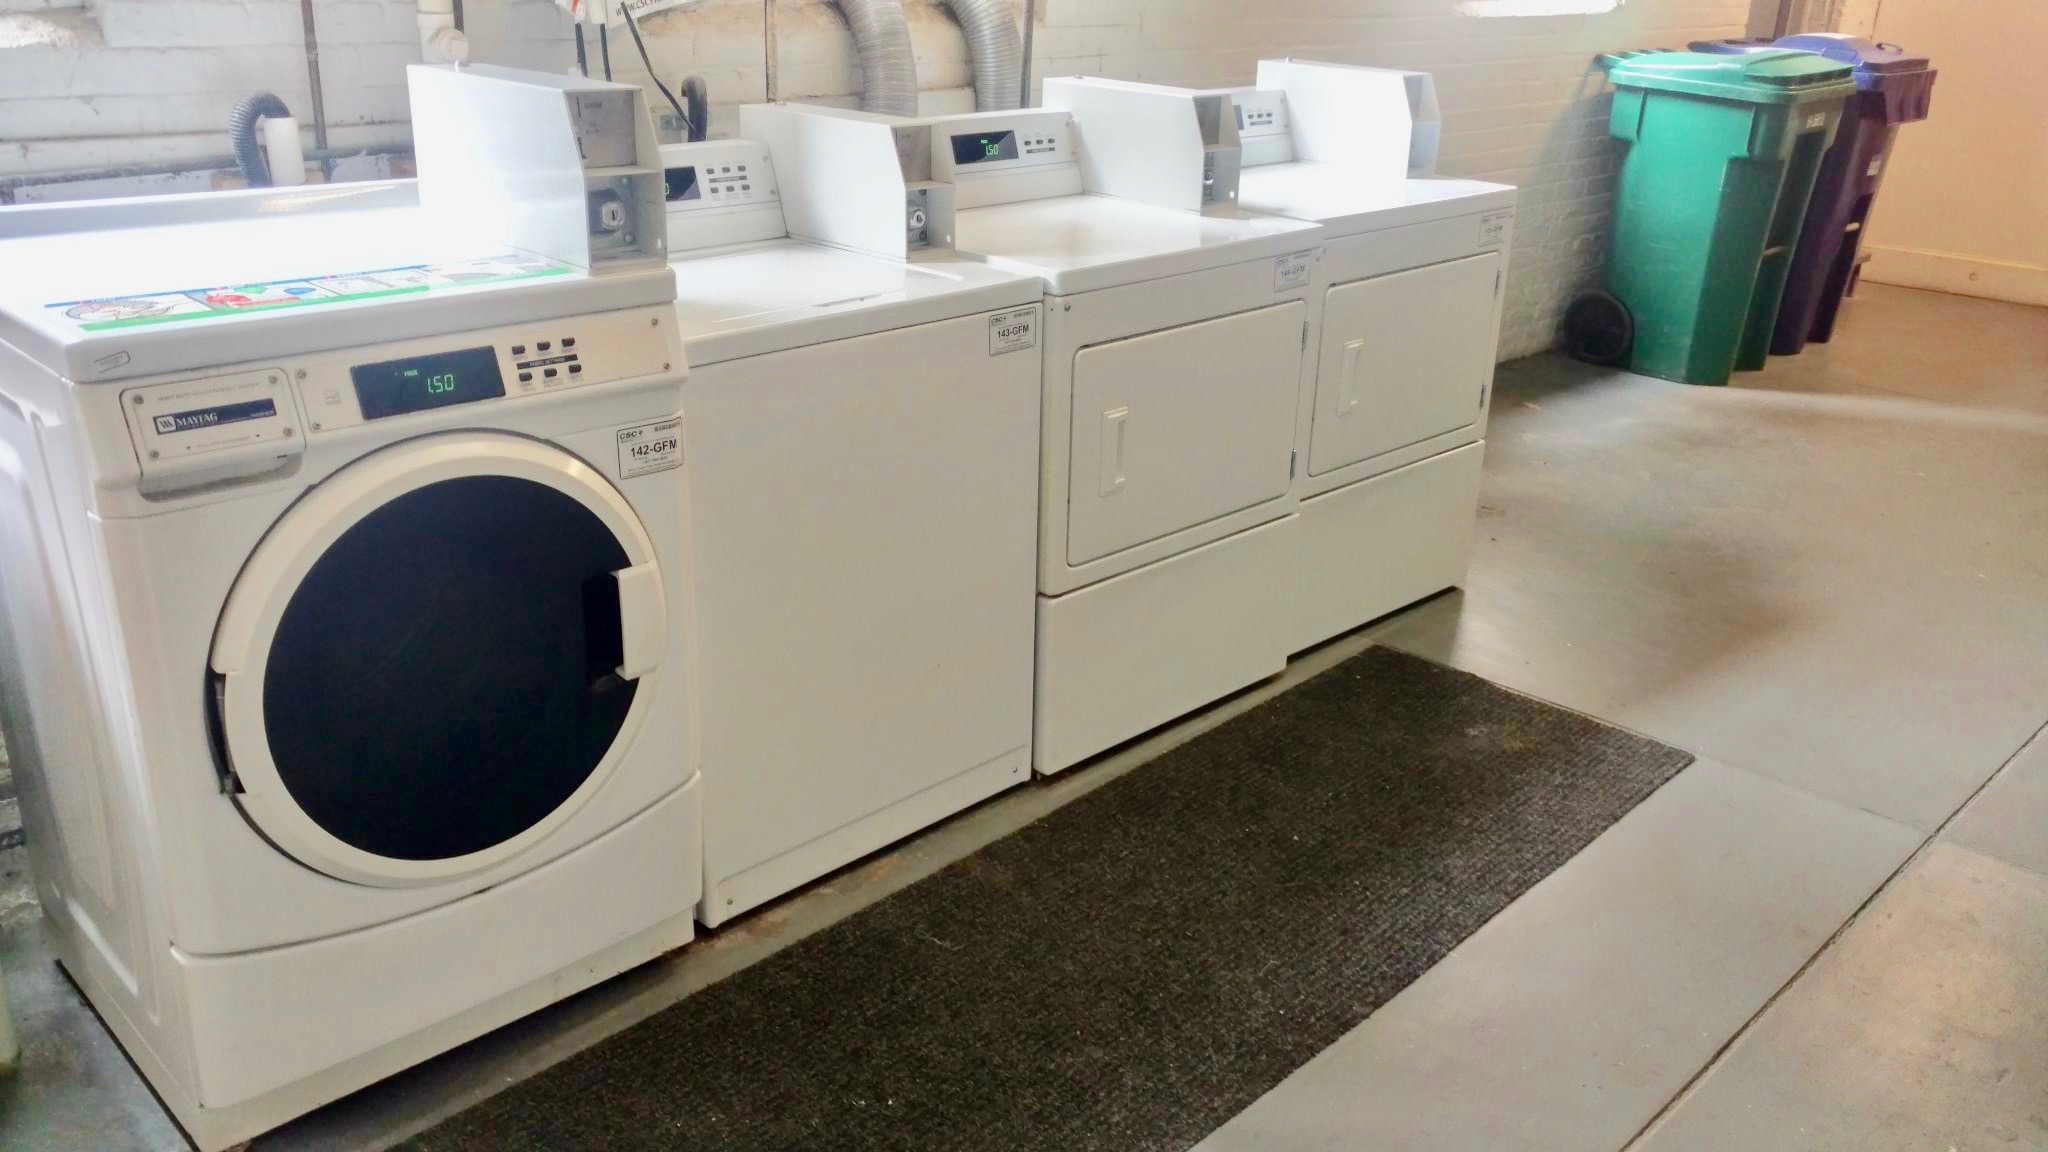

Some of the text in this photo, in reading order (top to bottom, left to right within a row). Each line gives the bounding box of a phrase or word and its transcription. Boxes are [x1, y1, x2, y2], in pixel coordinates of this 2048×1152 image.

[998, 324, 1029, 338] 143-GFM
[427, 373, 454, 393] 1.50
[176, 413, 218, 427] MAYTAG
[619, 430, 637, 440] CSC
[631, 438, 678, 457] 142-GFM
